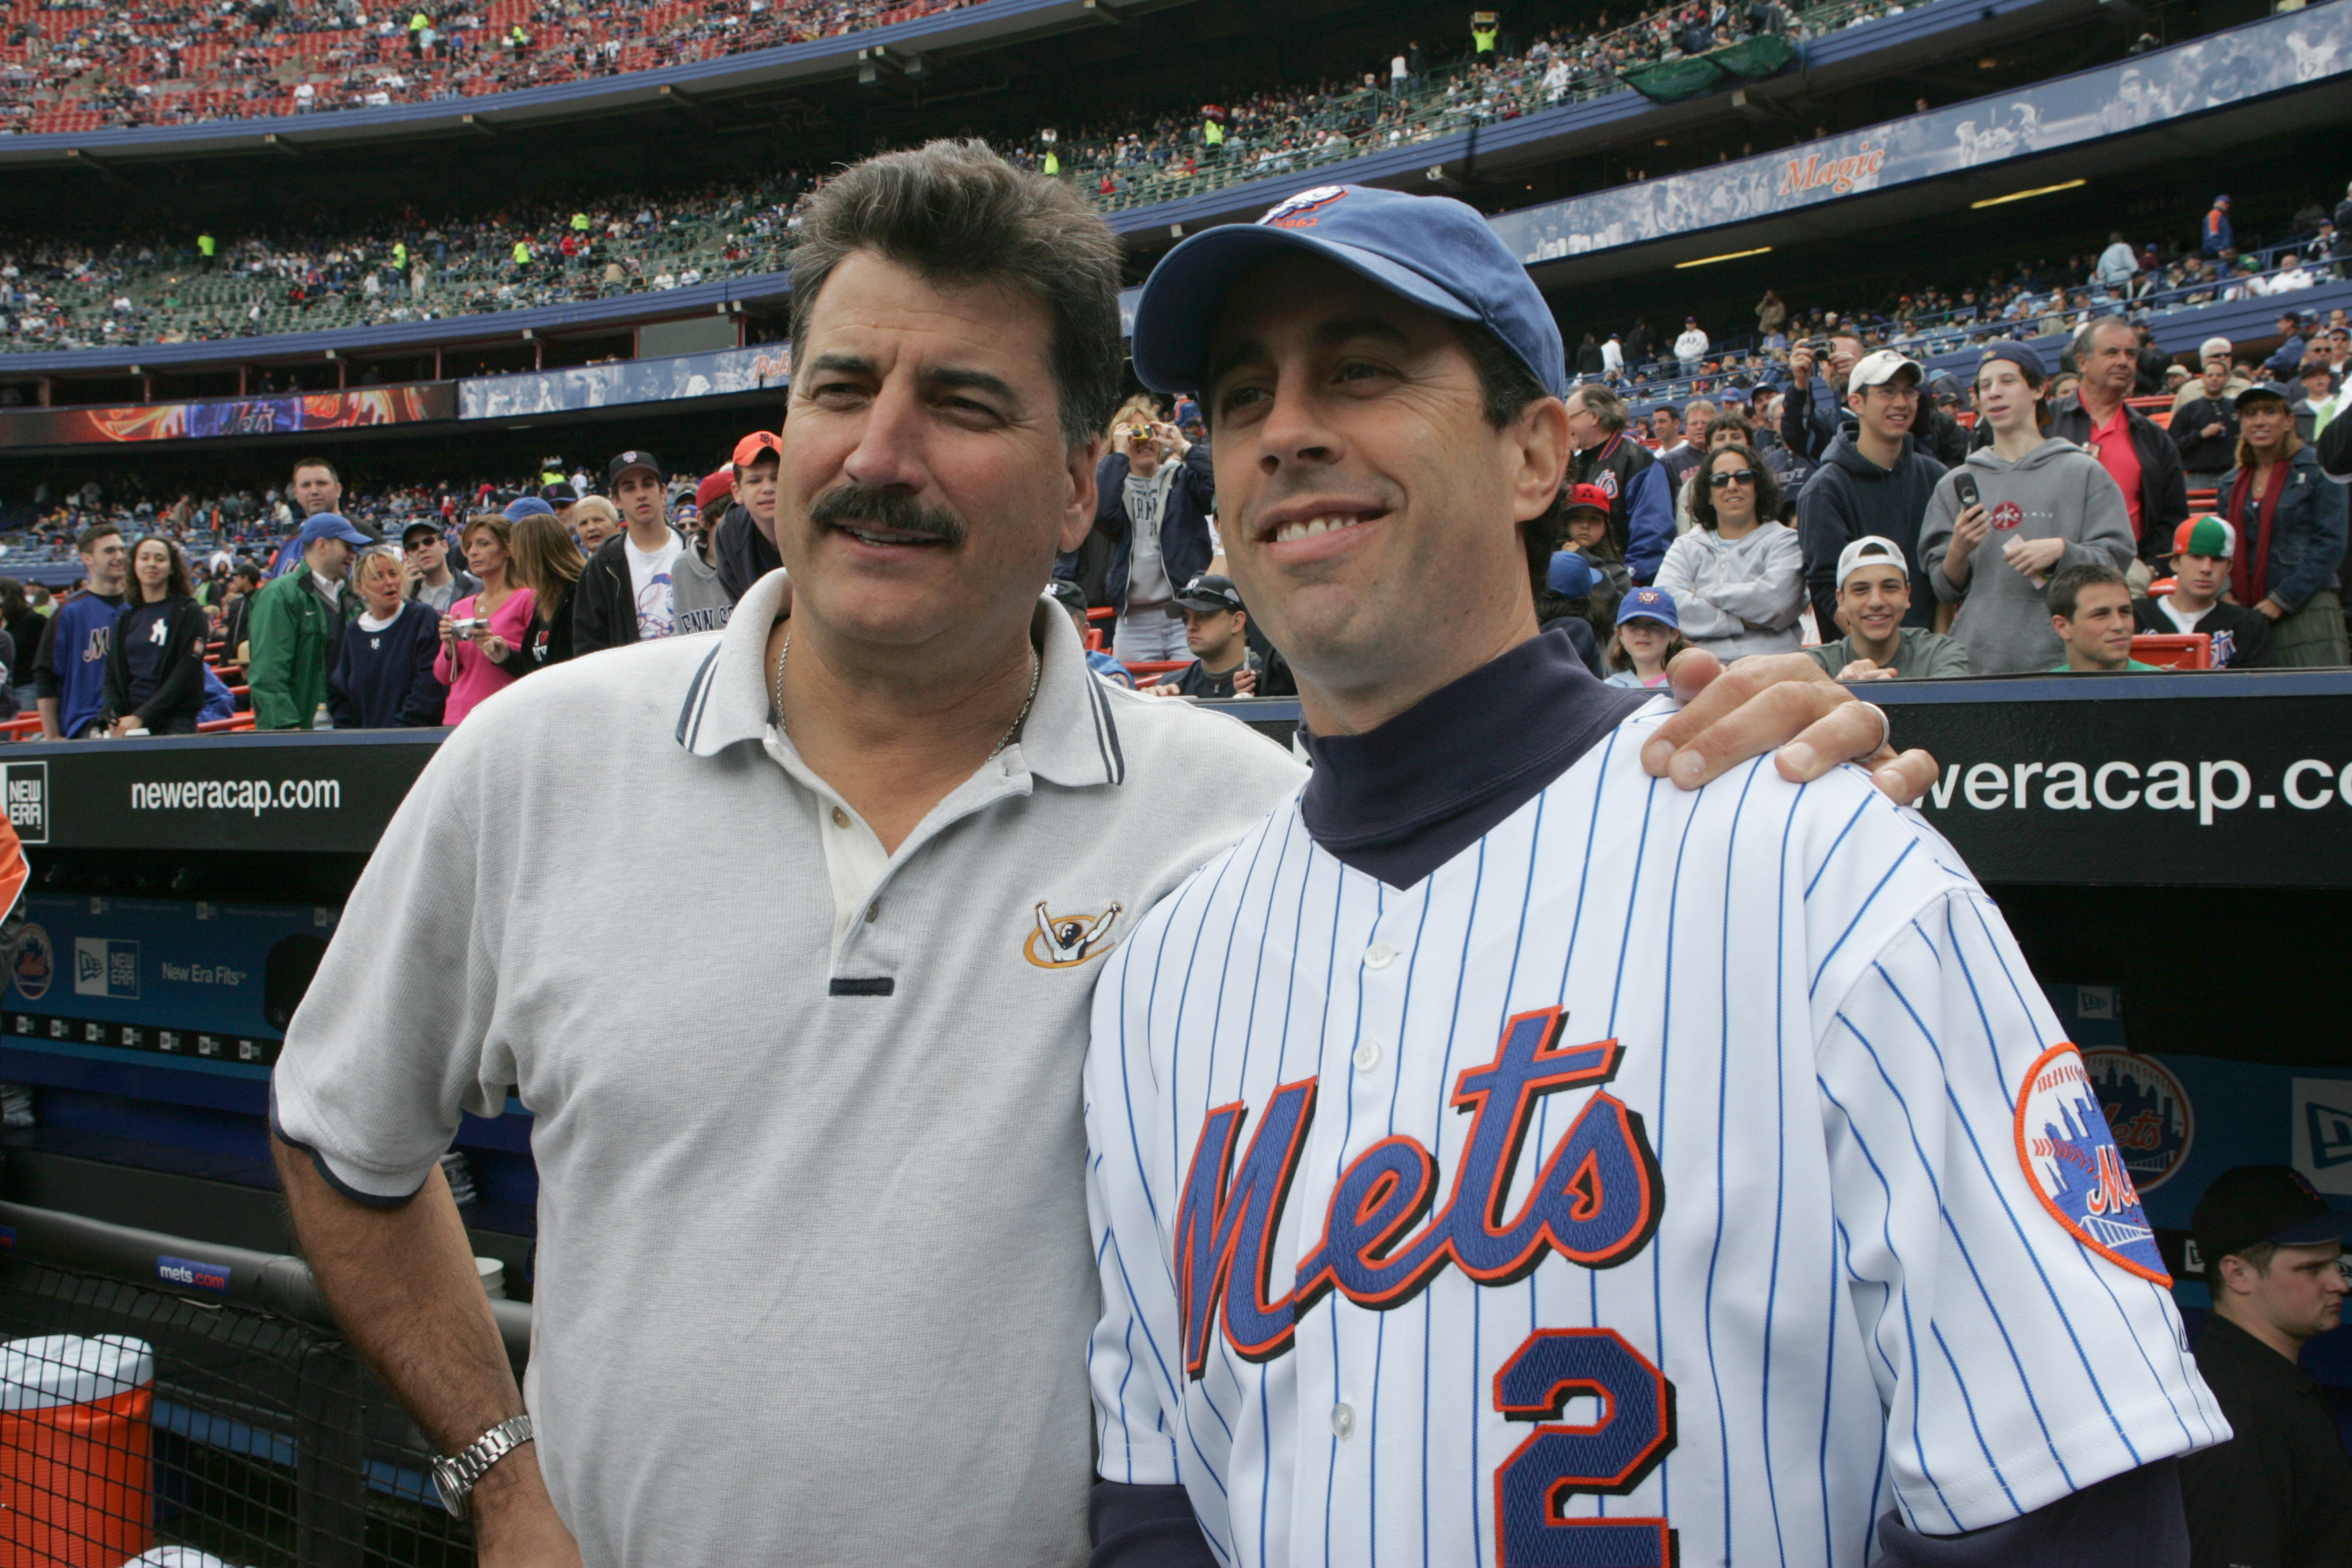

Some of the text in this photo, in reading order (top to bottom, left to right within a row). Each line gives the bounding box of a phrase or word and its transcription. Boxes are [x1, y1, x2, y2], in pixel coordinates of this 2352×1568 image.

[1777, 140, 1886, 197] Magic
[9, 779, 42, 803] NEW
[132, 779, 340, 817] neweracap.com
[10, 803, 42, 826] ERA
[110, 952, 135, 969] NEW
[162, 962, 189, 981] New
[191, 964, 213, 983] Era
[110, 969, 135, 987] ERA
[2105, 1103, 2164, 1150] ets
[1173, 1004, 1666, 1392] Mets
[159, 1265, 225, 1289] mets.com
[1493, 1327, 1679, 1568] 2
